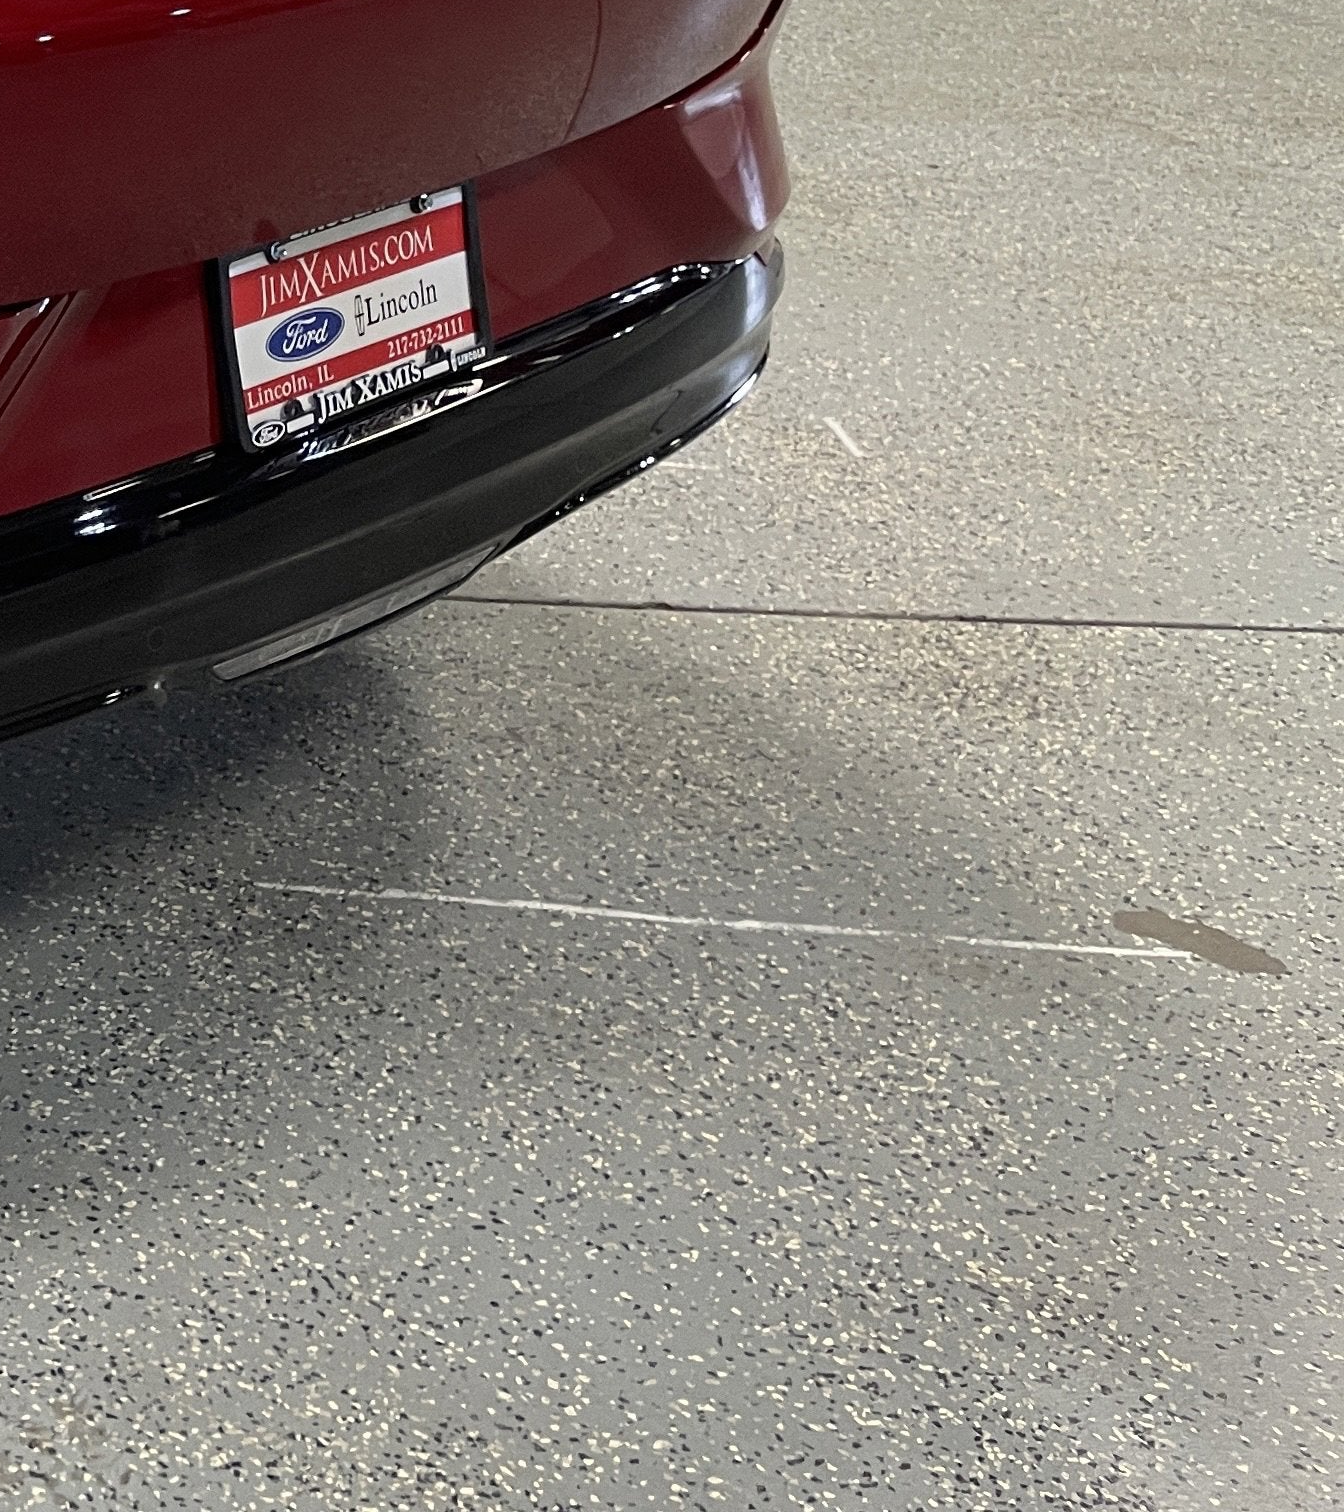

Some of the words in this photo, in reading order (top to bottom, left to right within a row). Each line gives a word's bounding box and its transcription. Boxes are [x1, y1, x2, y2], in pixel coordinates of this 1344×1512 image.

[366, 279, 438, 326] Lincoln
[282, 317, 329, 354] Ford
[317, 364, 335, 382] IL
[317, 390, 353, 423] JIM
[358, 362, 422, 405] XAMIS
